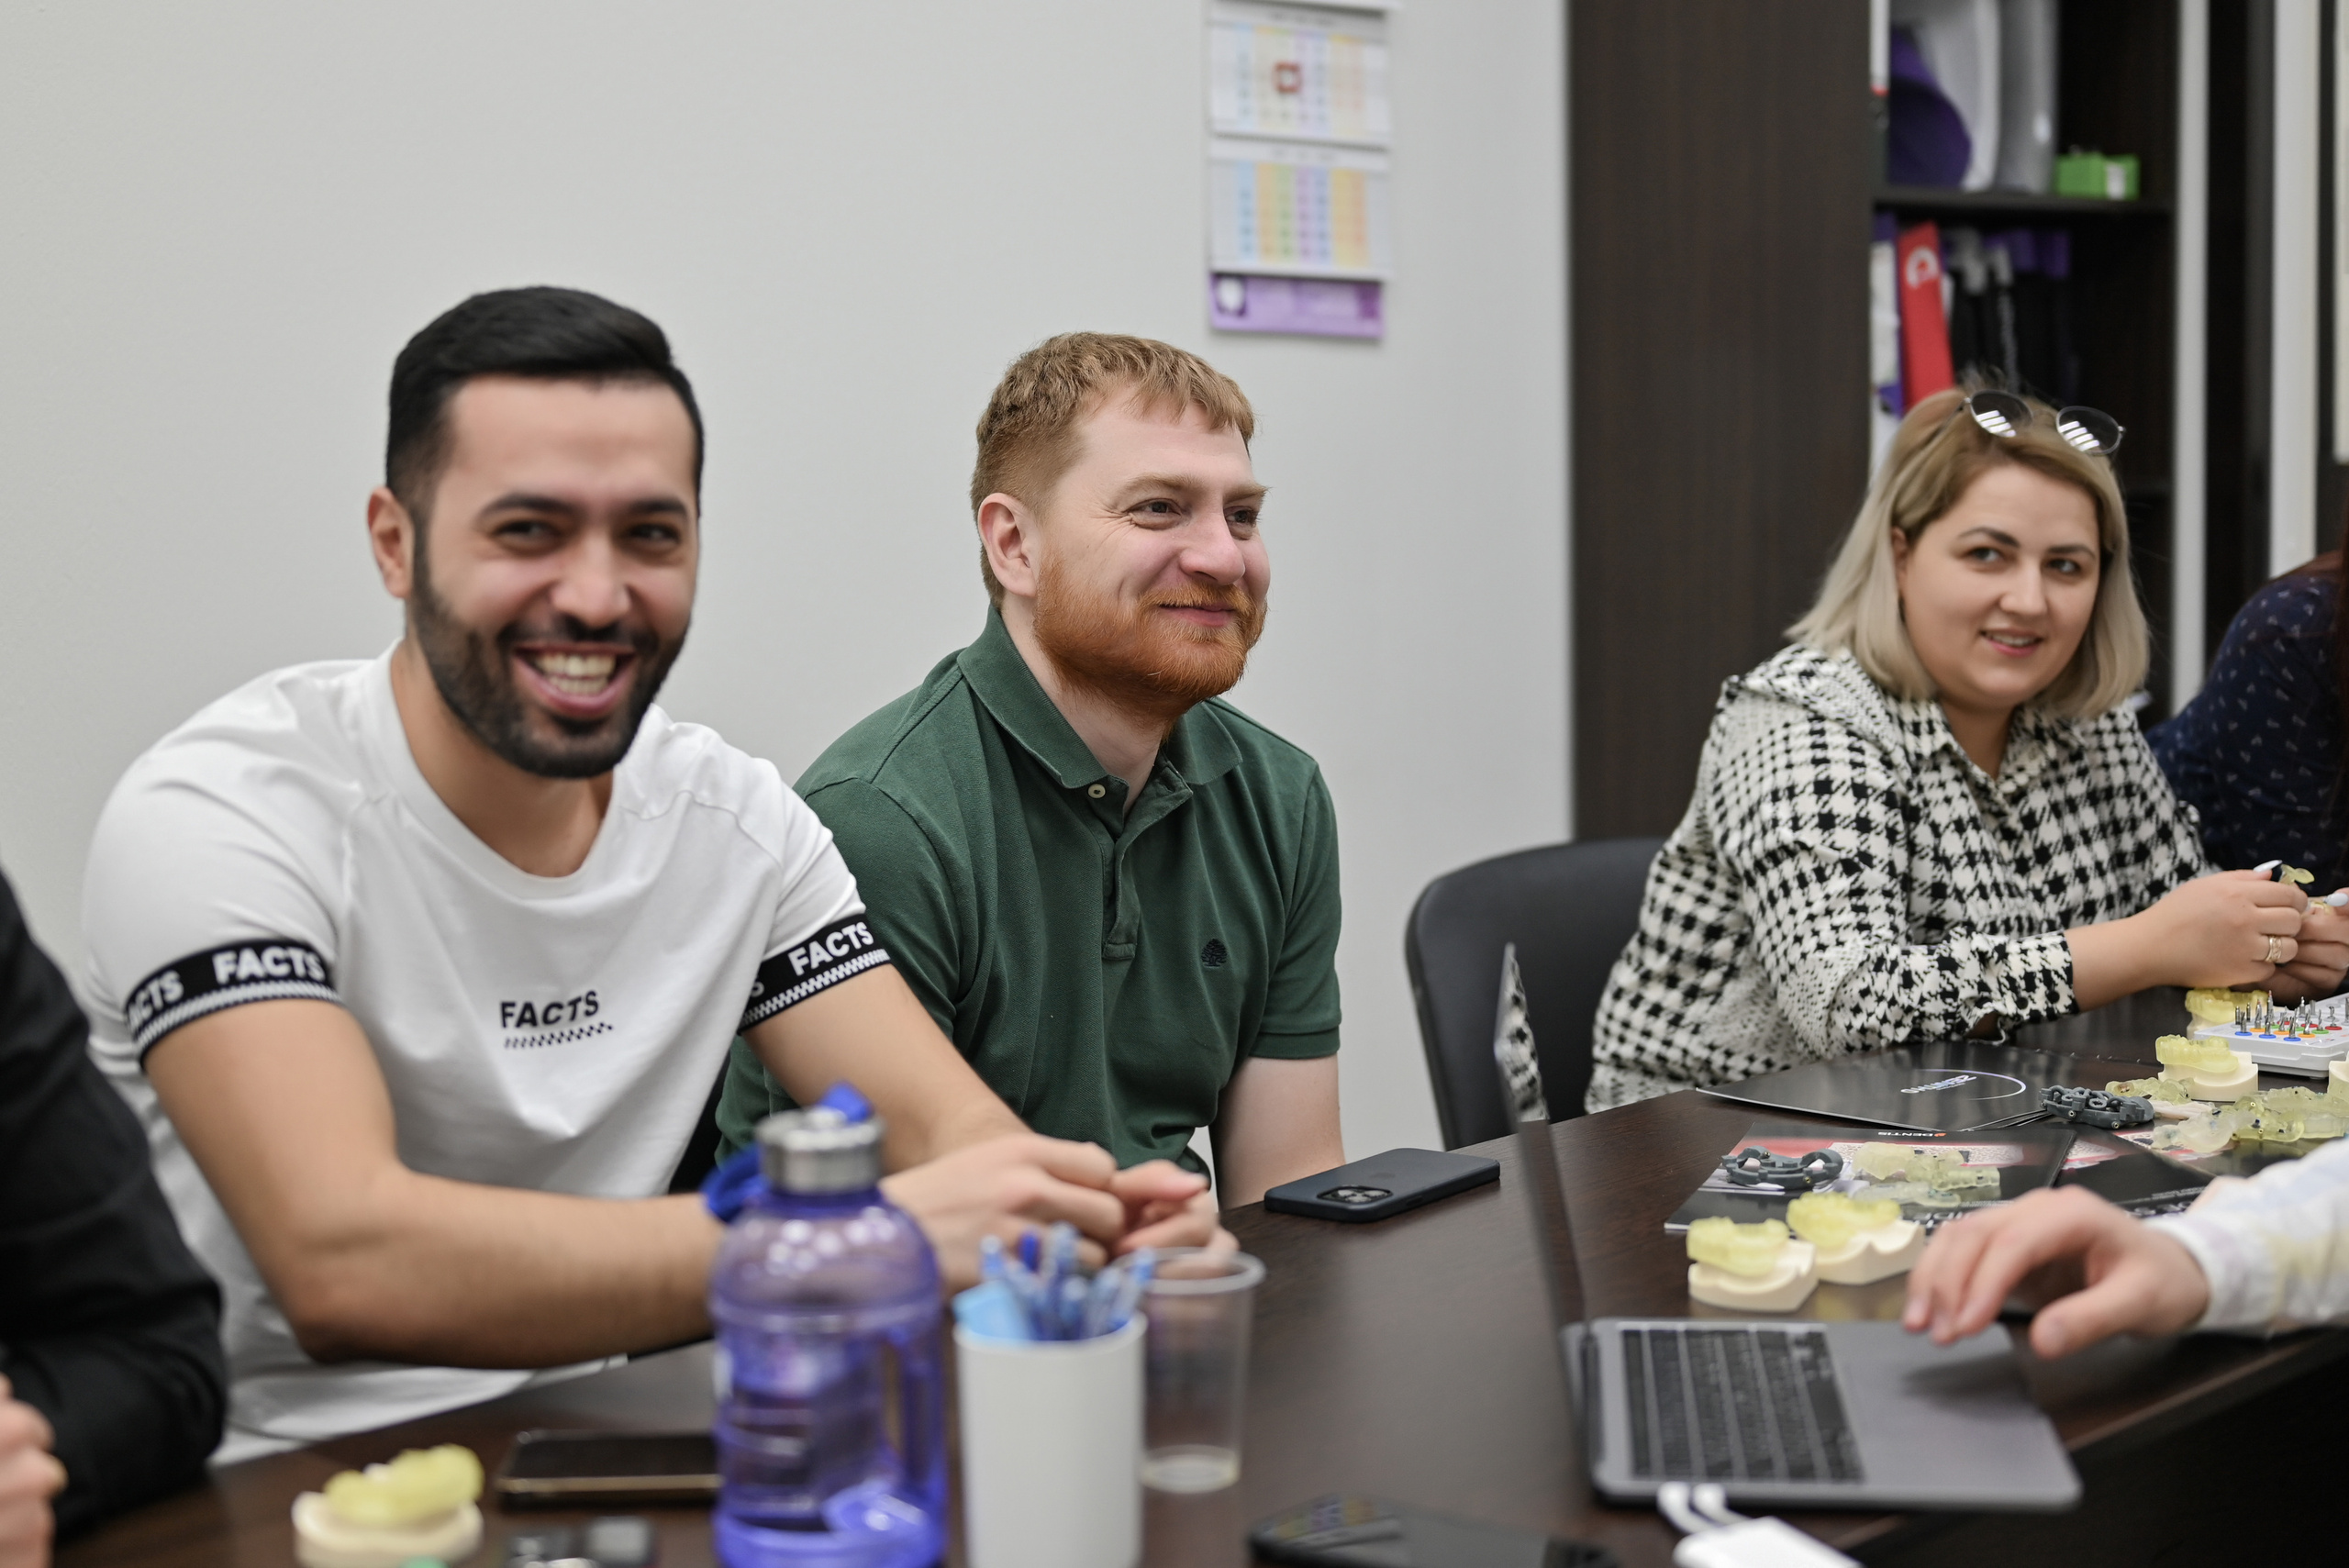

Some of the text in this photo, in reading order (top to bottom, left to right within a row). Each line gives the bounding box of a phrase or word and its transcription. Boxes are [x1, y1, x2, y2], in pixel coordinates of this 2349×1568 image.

[787, 921, 874, 976] FACTS
[128, 946, 326, 1031] ACTS FACTS
[501, 990, 599, 1029] FACTS
